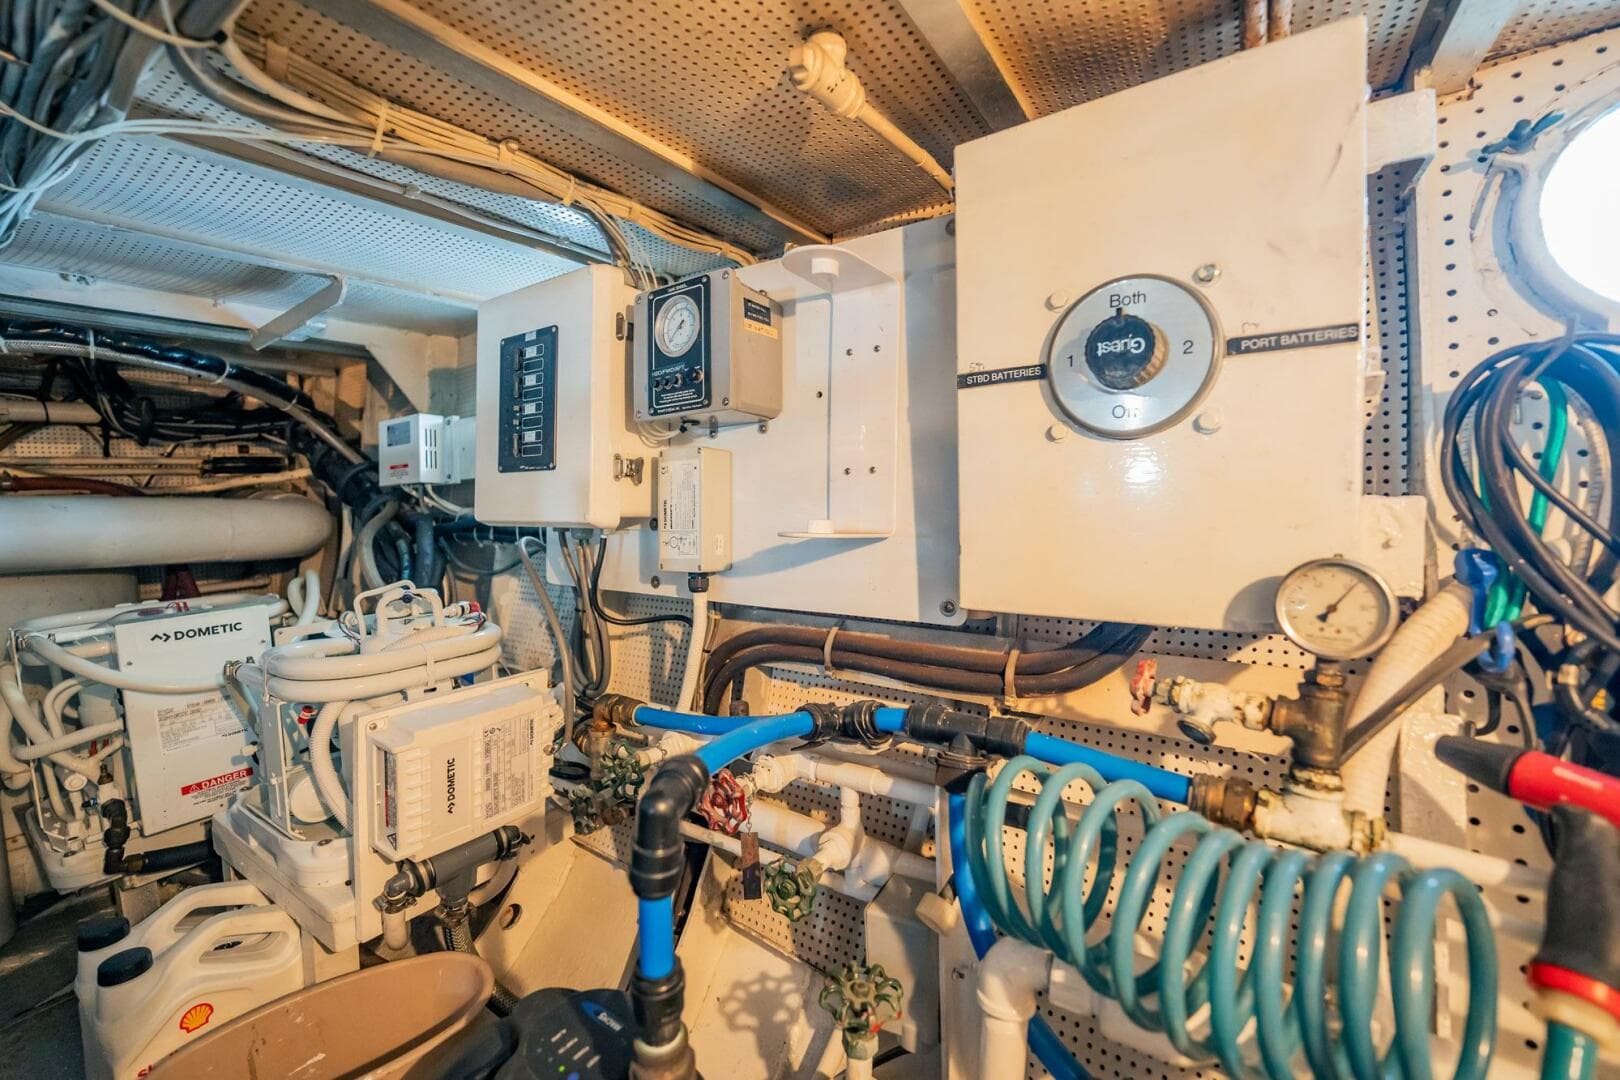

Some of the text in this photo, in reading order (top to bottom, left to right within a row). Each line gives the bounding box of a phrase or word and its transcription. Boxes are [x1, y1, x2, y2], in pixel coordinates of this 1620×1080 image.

[1110, 290, 1147, 308] Both
[1096, 334, 1146, 356] Guest
[1182, 340, 1194, 354] 2
[1241, 336, 1278, 350] PORT
[1280, 325, 1358, 346] BATTERIES
[1067, 355, 1074, 367] 1
[966, 374, 990, 385] STBD
[991, 366, 1042, 381] BATTERIES
[174, 622, 243, 641] DOMETIC
[202, 769, 248, 789] DANGER
[447, 757, 456, 802] DOMETIC
